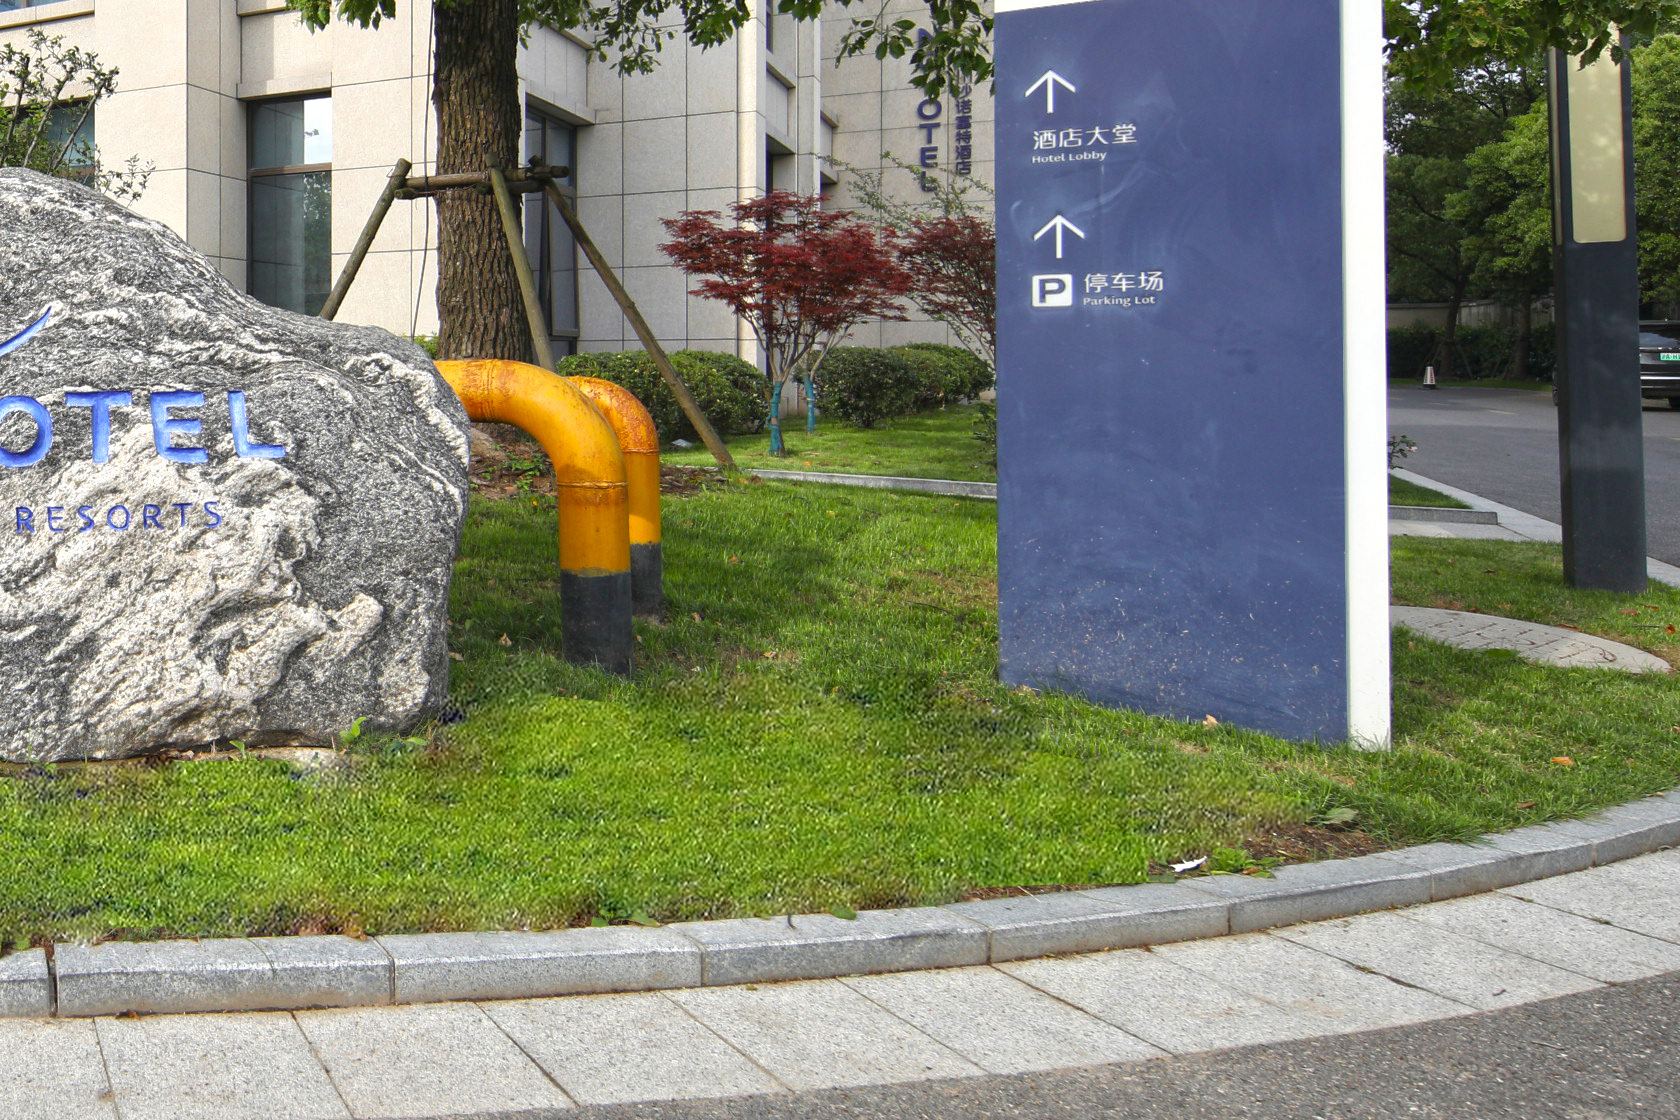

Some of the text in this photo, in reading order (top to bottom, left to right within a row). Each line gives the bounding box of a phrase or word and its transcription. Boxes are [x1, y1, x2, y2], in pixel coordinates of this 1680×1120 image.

[1033, 123, 1137, 150] 酒店大堂
[1032, 151, 1108, 164] Hotel Lobby
[1038, 278, 1067, 304] P
[1083, 271, 1164, 294] 停车场
[1083, 295, 1157, 308] Parking Lot
[15, 500, 224, 535] RESORTS
